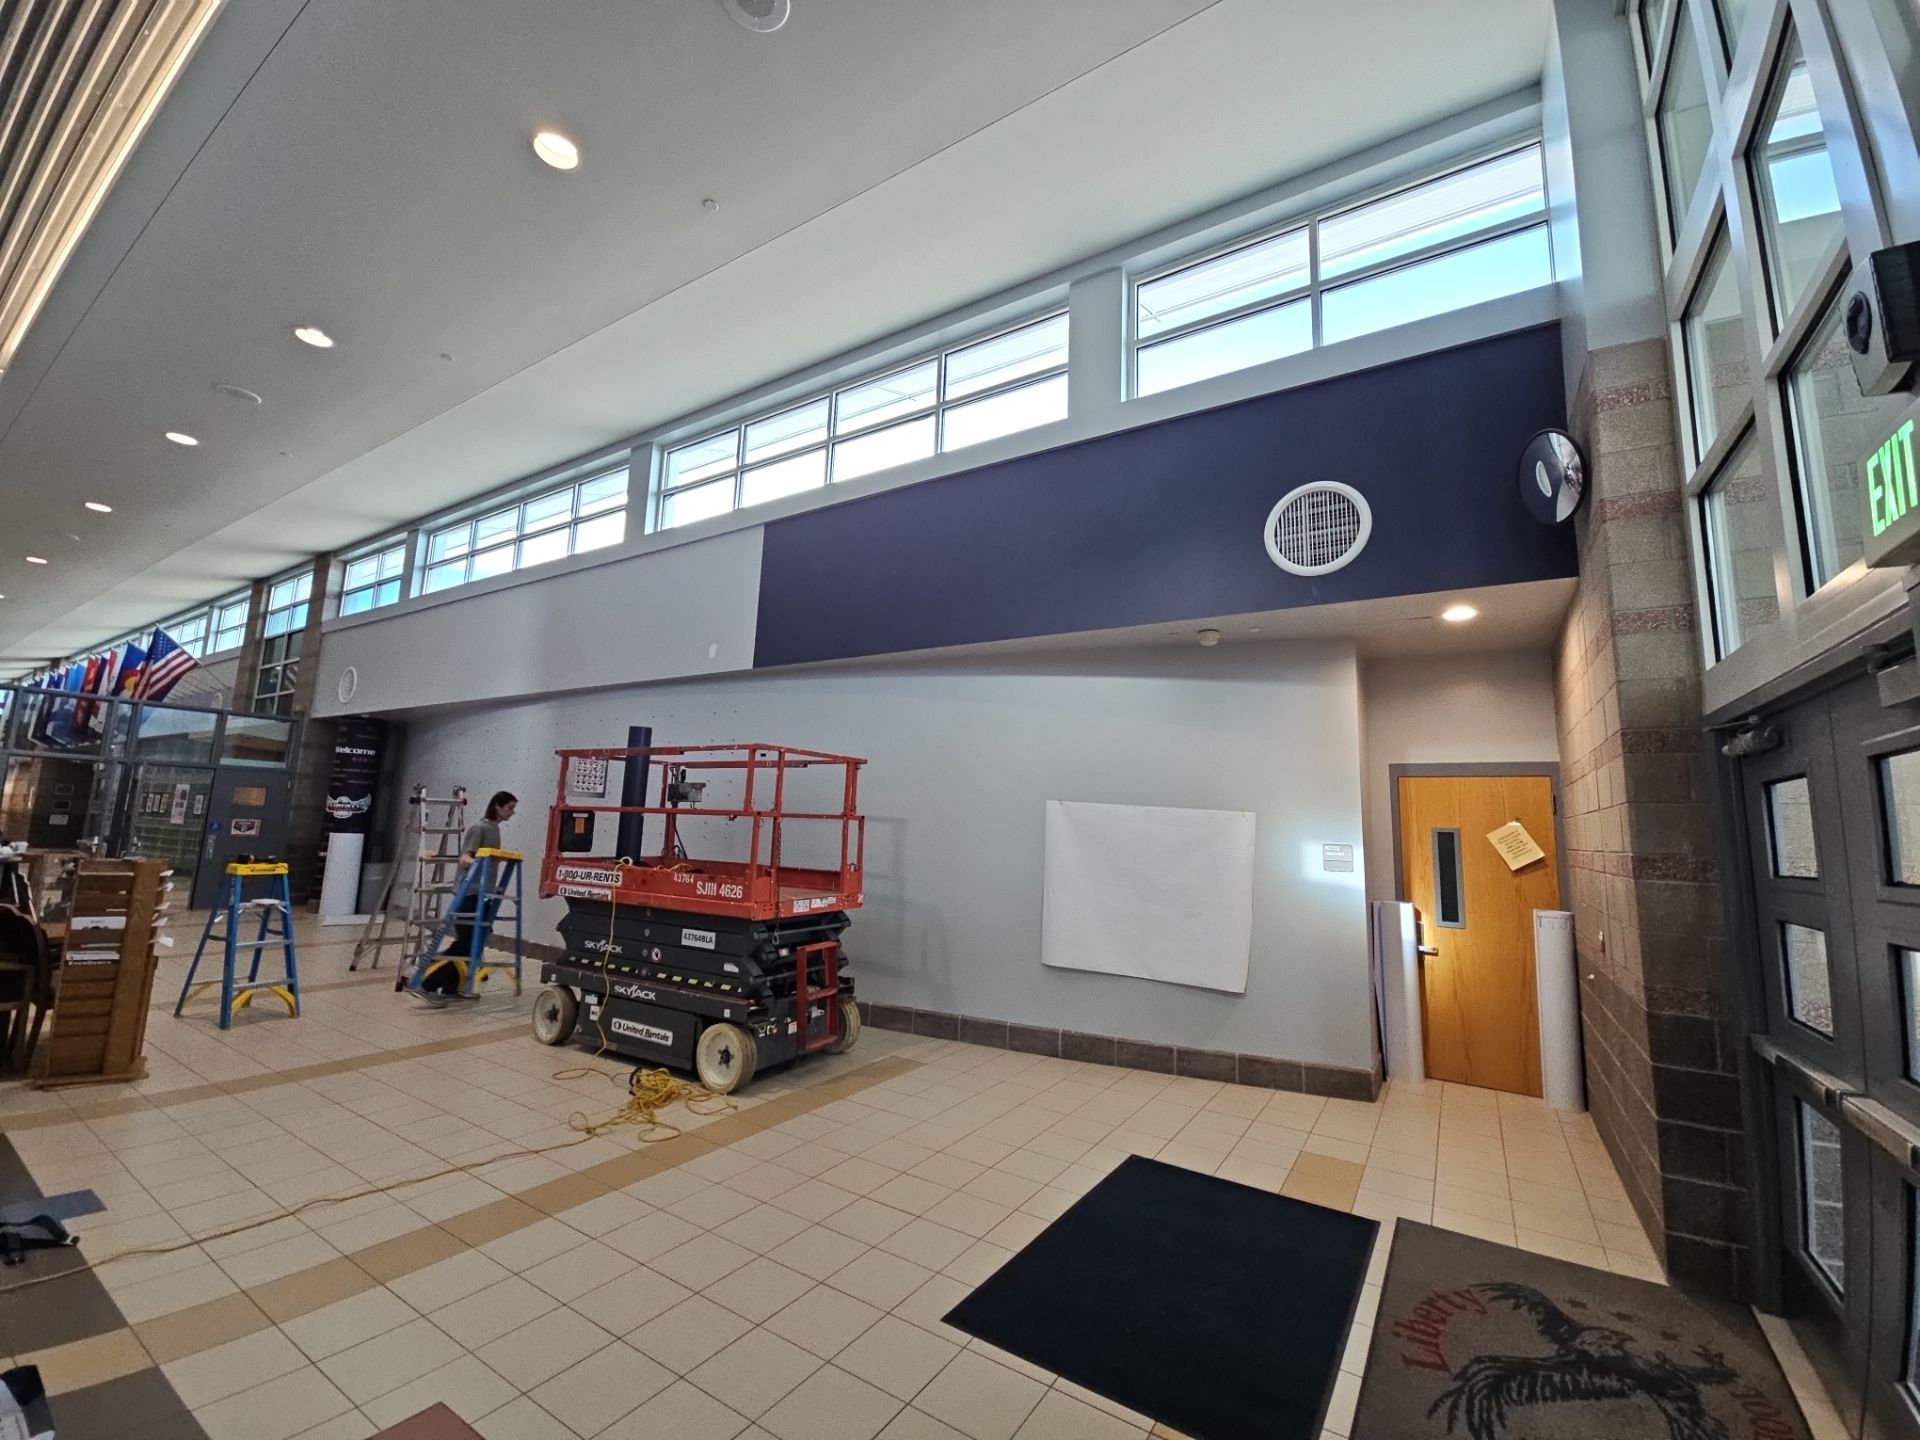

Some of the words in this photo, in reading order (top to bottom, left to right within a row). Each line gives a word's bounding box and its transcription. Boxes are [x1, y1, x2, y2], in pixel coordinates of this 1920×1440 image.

[1866, 418, 1918, 537] EXIT
[558, 869, 621, 884] 1-800-UR-RENTS
[567, 888, 586, 897] United
[719, 883, 743, 899] 4626
[622, 1023, 644, 1036] United
[644, 1028, 670, 1042] Rentals
[1392, 1287, 1488, 1375] Liberty
